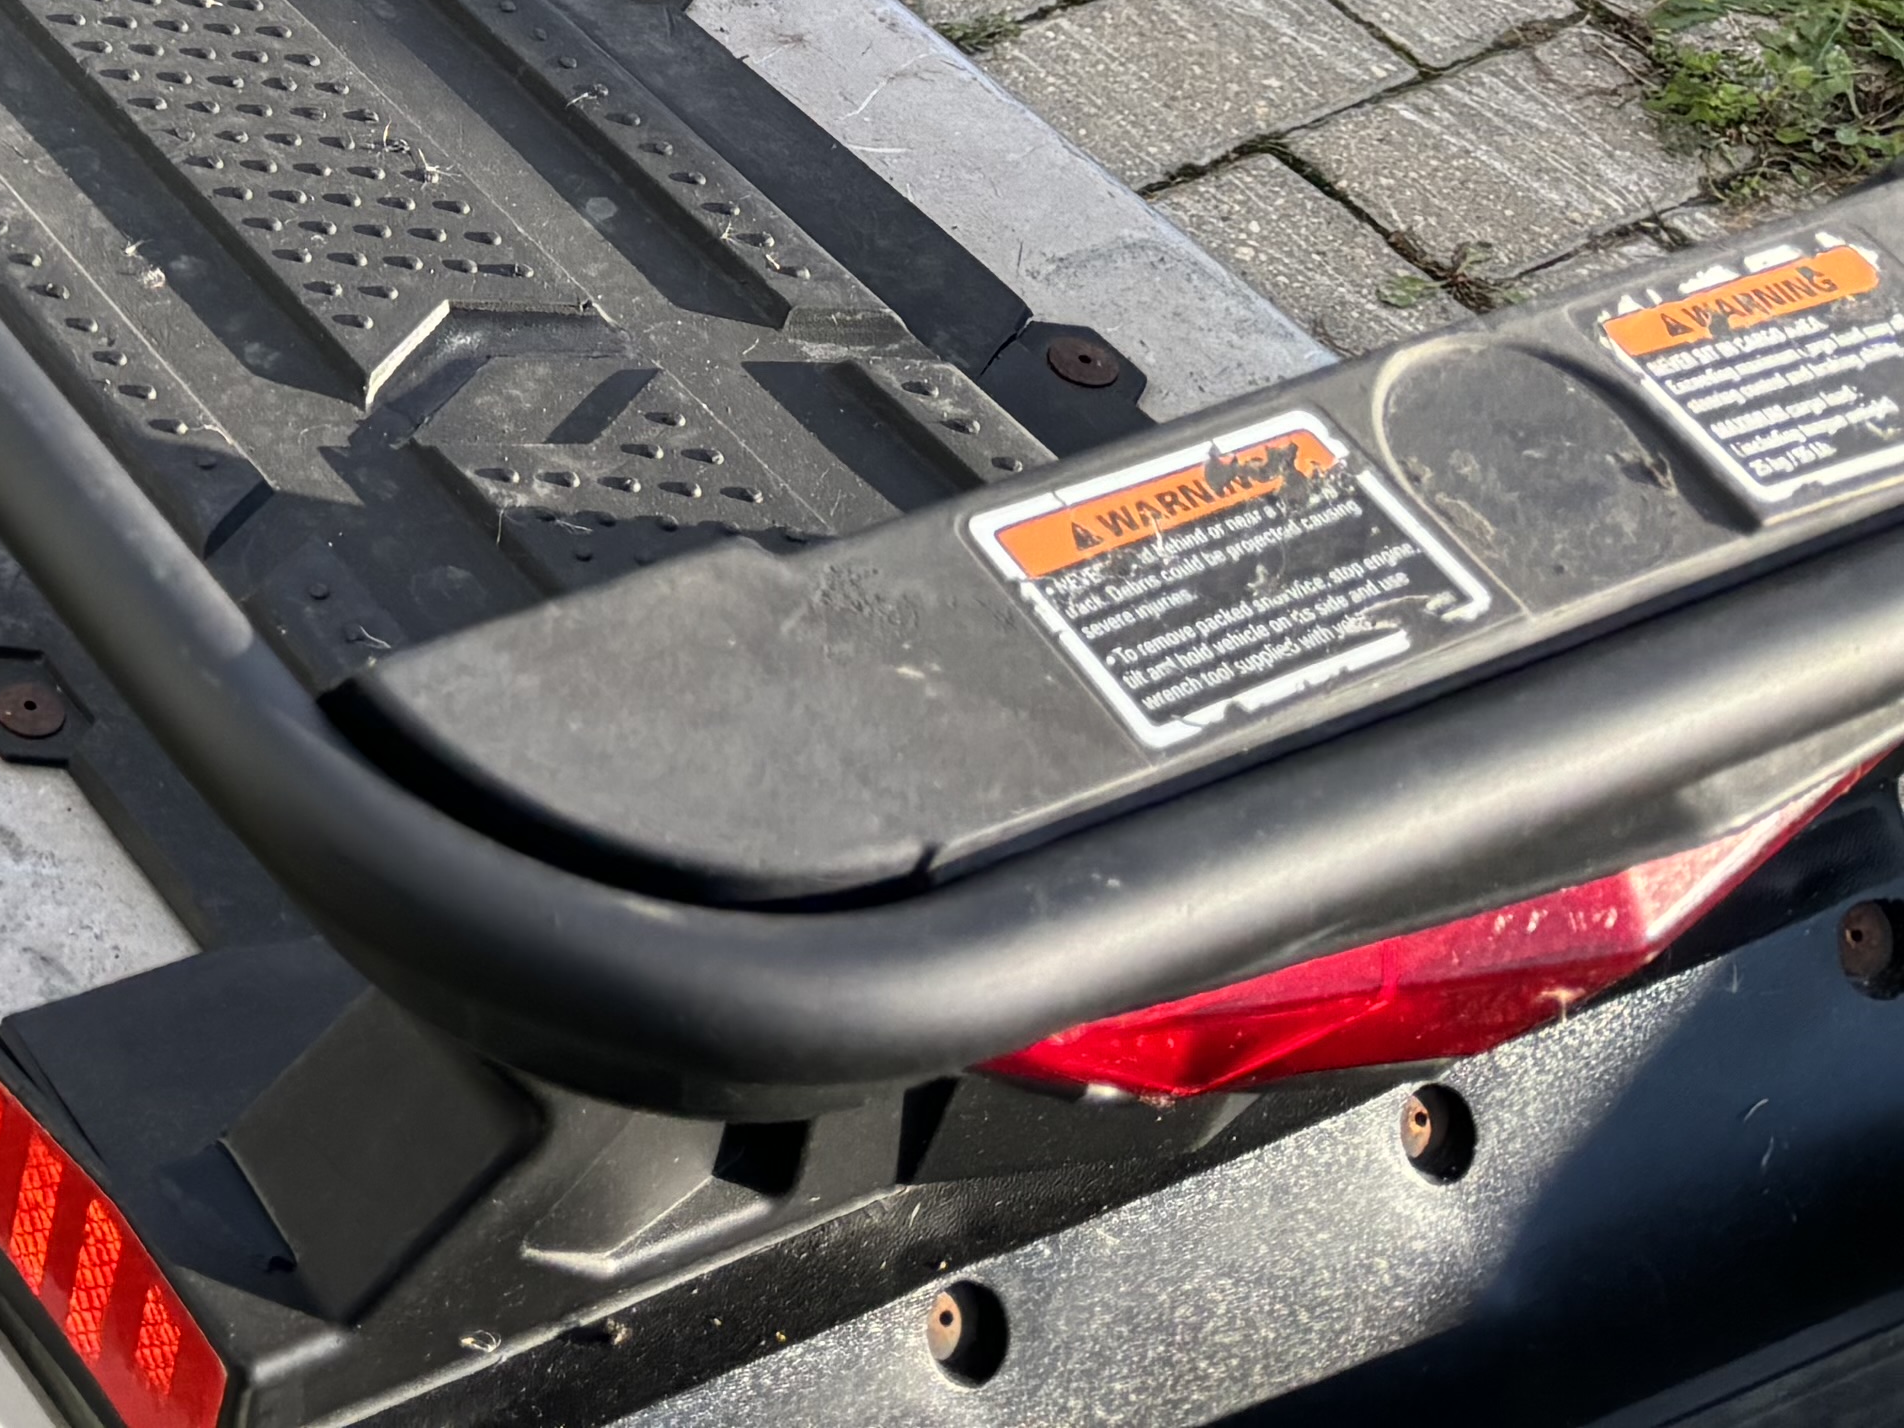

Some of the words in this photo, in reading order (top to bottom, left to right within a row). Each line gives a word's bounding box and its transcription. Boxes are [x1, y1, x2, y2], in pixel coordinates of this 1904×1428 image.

[1647, 352, 1698, 376] NEVER
[1692, 346, 1719, 363] SIT
[1716, 341, 1739, 356] IN
[1786, 367, 1814, 385] and
[1711, 405, 1789, 438] MAXIMUM
[1786, 397, 1827, 418] cargo
[1208, 524, 1224, 538] or
[1105, 575, 1161, 602] Debris
[1161, 555, 1205, 581] could
[1201, 550, 1226, 566] be
[1082, 612, 1135, 639] severe
[1114, 649, 1138, 663] To
[1137, 626, 1196, 655] remove
[1196, 601, 1253, 637] packed
[1329, 563, 1365, 583] stop
[1123, 670, 1148, 689] tilt
[1174, 643, 1214, 668] hold
[1213, 624, 1270, 654] vehicle
[1269, 617, 1292, 632] on
[1315, 596, 1348, 615] side
[1349, 581, 1381, 603] and
[1378, 573, 1409, 591] use
[1142, 677, 1203, 709] wrench
[1201, 662, 1234, 686] tool
[1234, 638, 1301, 674] supplied
[1298, 626, 1334, 649] with
